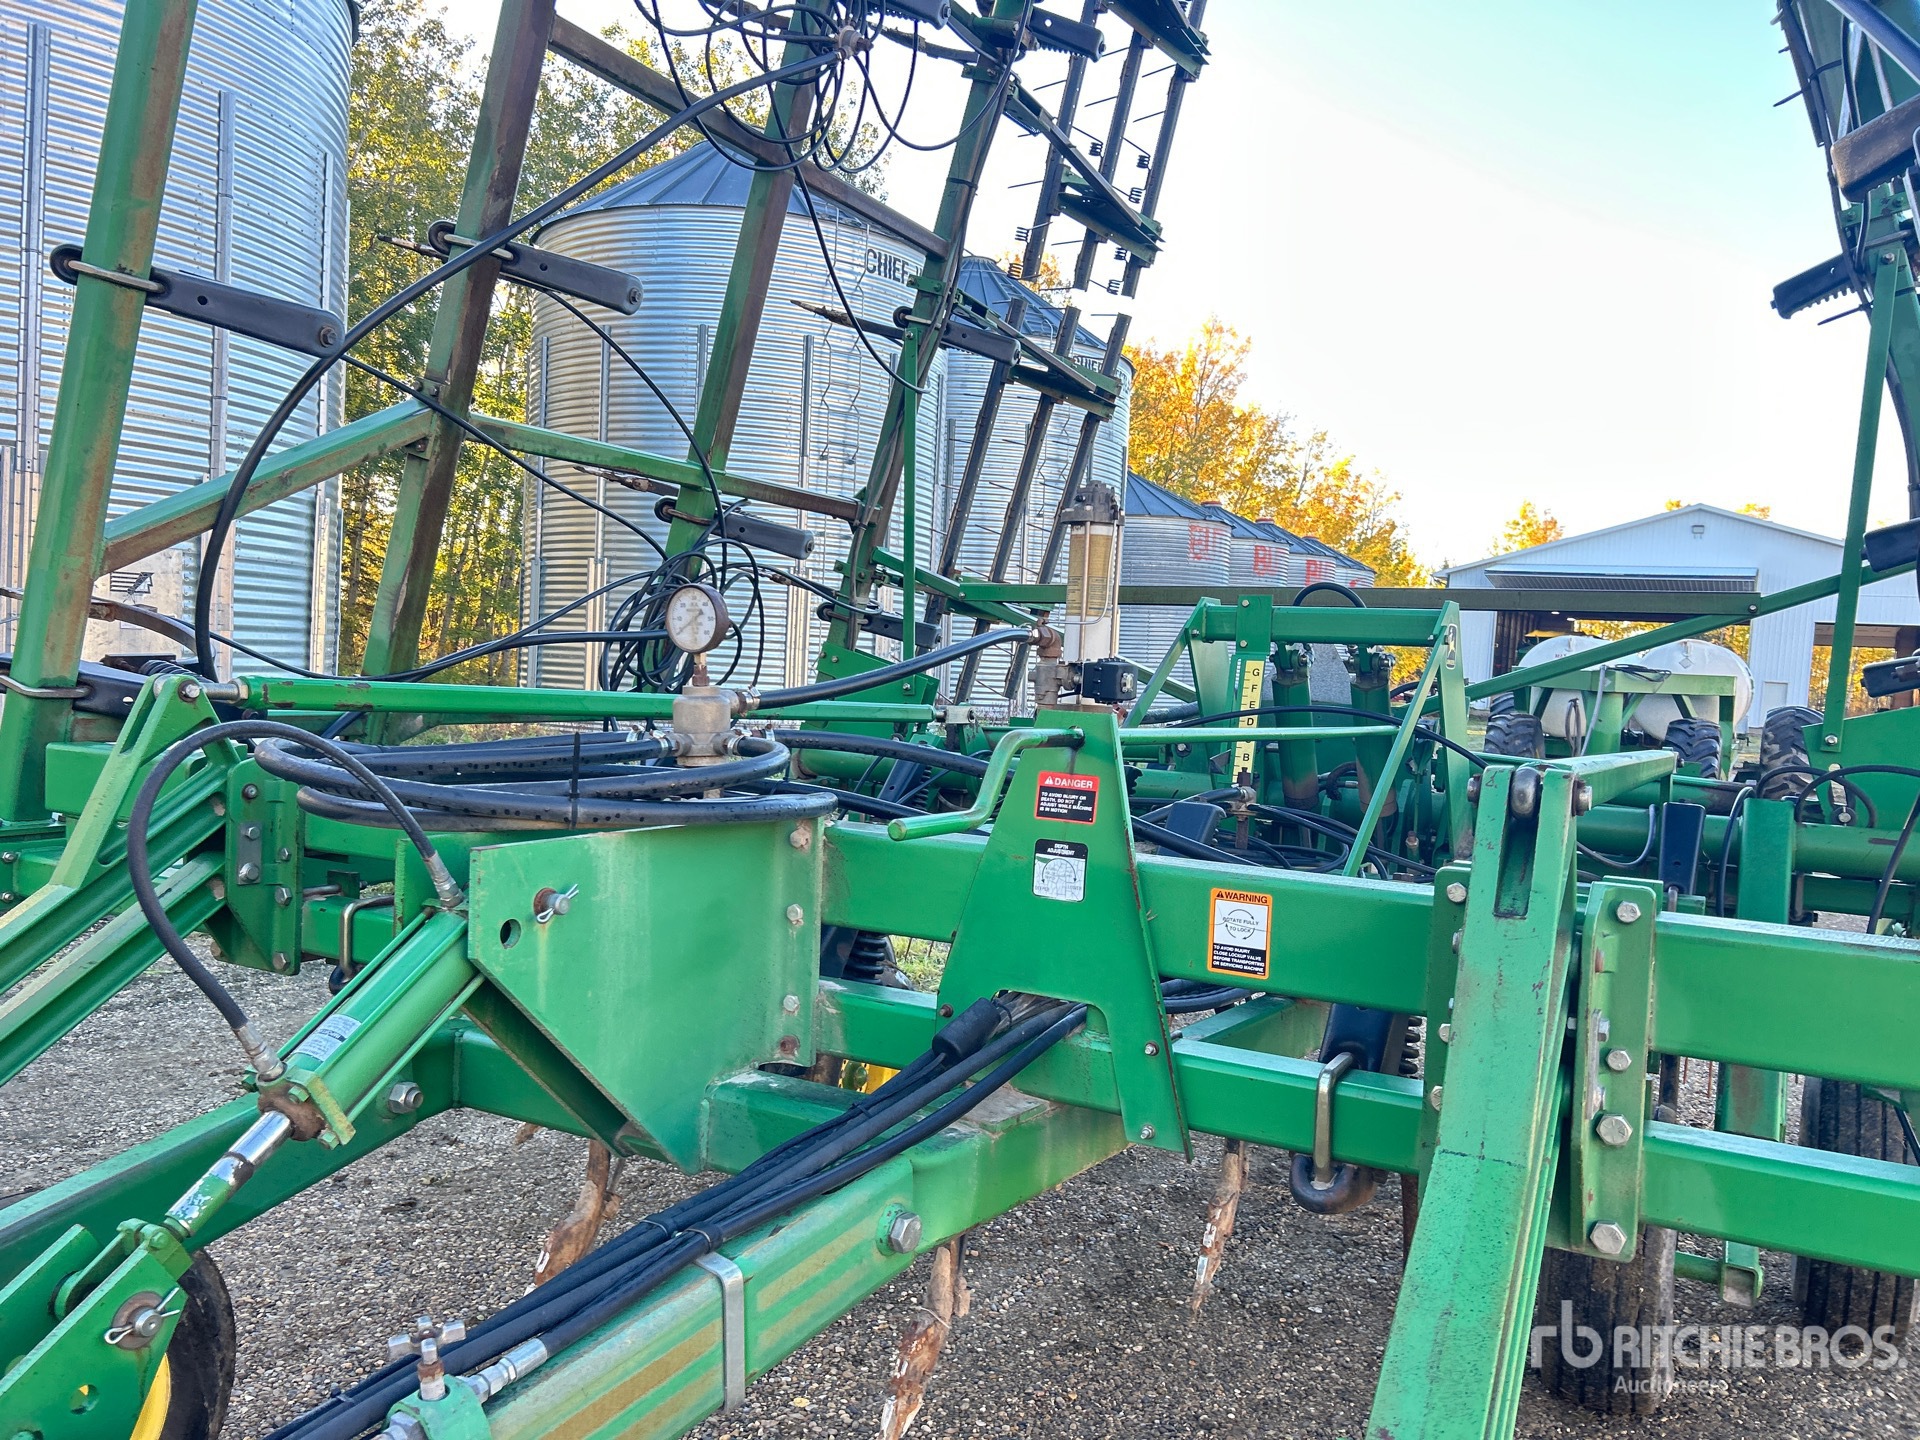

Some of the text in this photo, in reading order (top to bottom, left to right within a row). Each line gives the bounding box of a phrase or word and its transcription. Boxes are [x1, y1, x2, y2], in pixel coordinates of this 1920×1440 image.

[865, 248, 909, 284] CHIEF
[1252, 668, 1260, 676] G
[1251, 684, 1258, 692] F
[1246, 718, 1254, 726] D
[1243, 753, 1250, 761] B
[1054, 777, 1093, 789] DANGER
[1047, 848, 1075, 856] ADJUSTMENT
[1225, 891, 1268, 904] WARNING
[1231, 958, 1264, 967] TRANSPORTING
